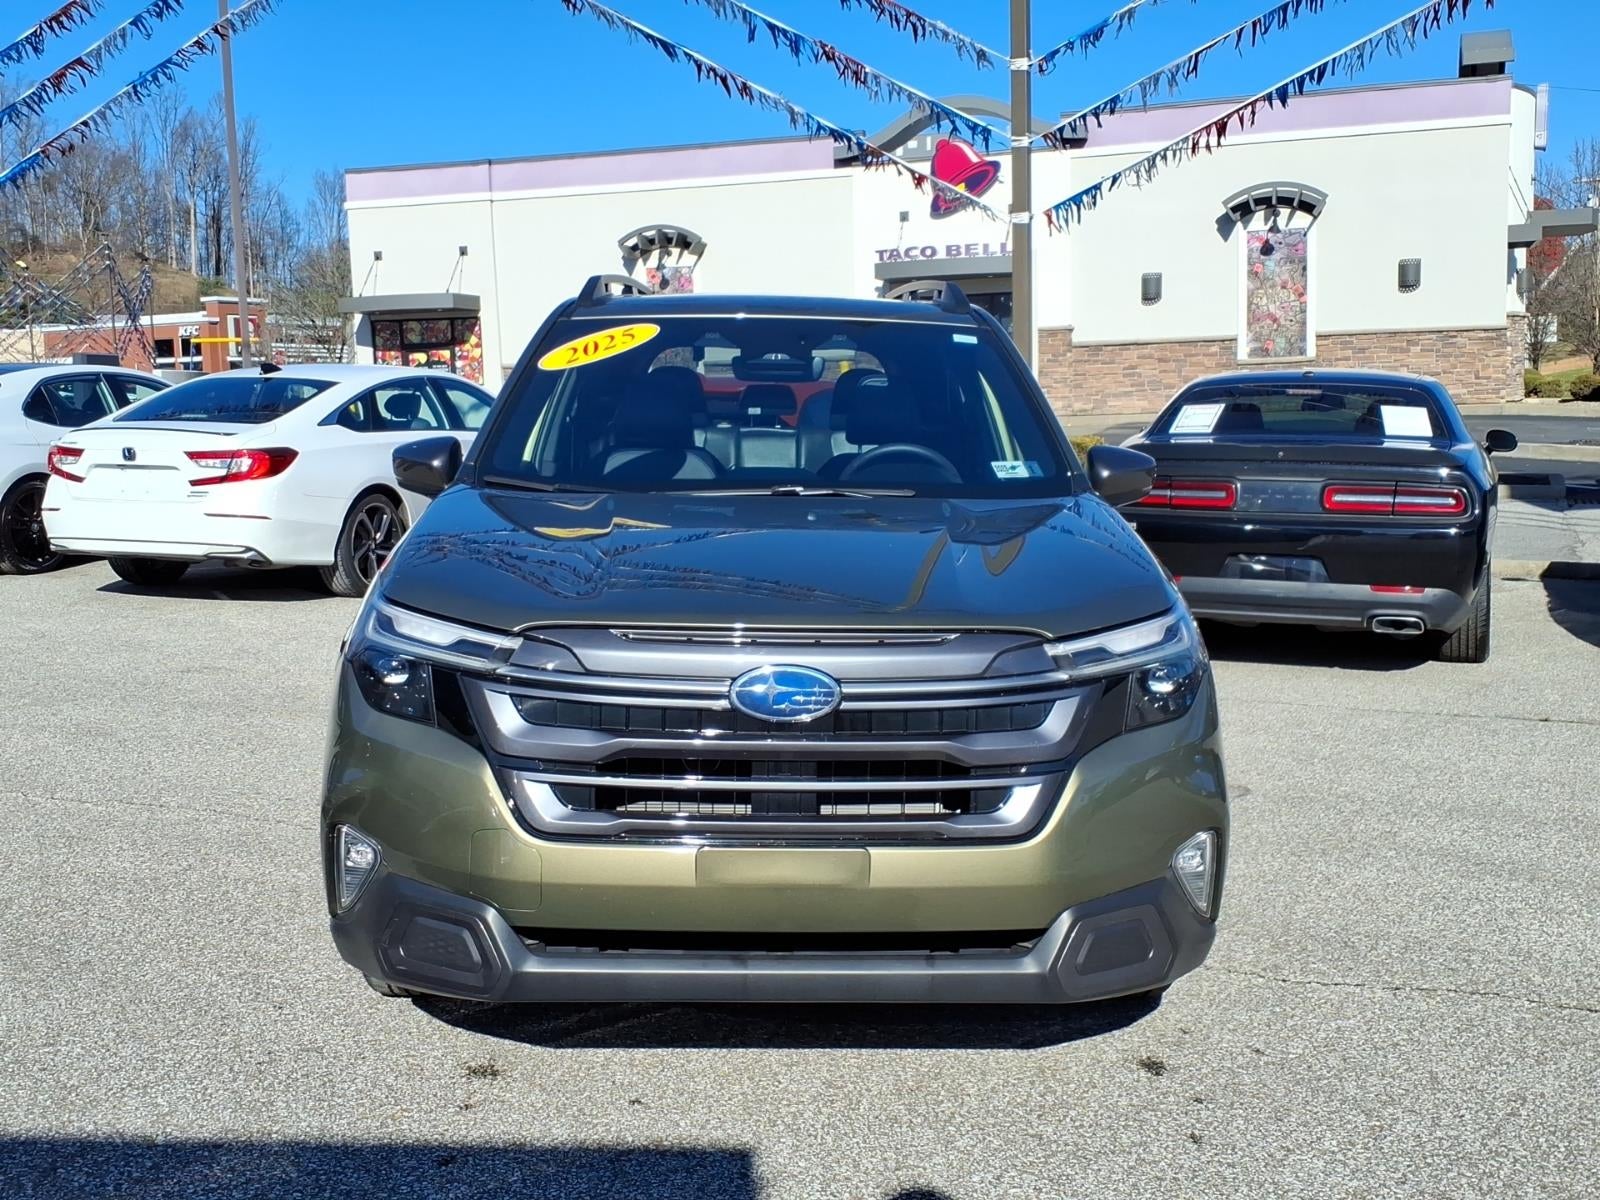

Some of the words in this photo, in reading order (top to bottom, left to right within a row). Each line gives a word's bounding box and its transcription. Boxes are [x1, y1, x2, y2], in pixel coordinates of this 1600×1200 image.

[875, 245, 938, 262] TACO
[945, 242, 1013, 257] BELL
[178, 325, 200, 338] KFC
[565, 327, 636, 365] 2025
